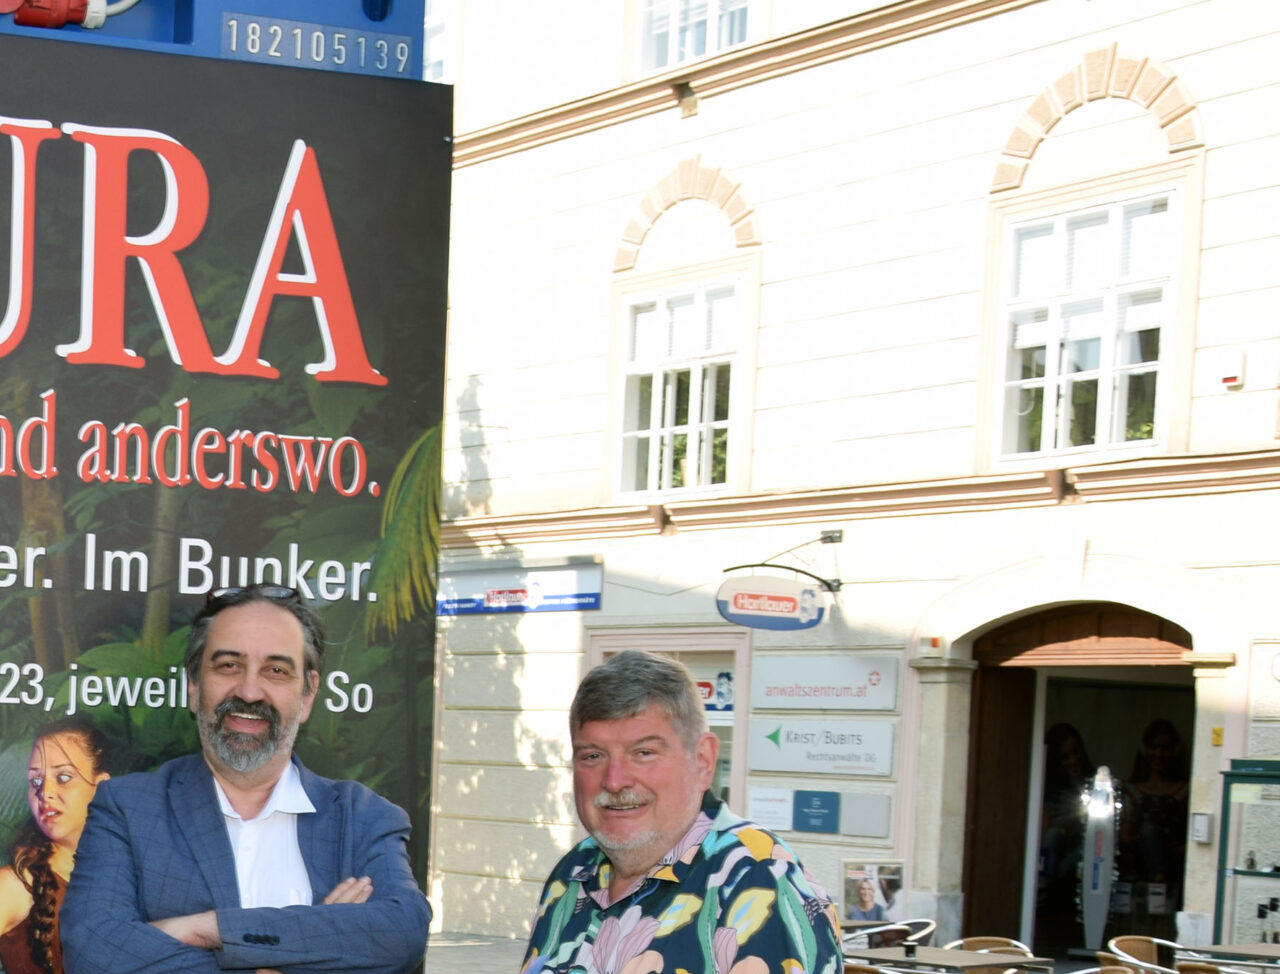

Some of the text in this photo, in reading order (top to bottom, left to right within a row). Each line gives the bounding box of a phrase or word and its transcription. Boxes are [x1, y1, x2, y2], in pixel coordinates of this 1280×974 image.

[227, 19, 410, 73] 182105139
[77, 397, 382, 498] anderswo.
[84, 533, 148, 592] Im
[179, 537, 378, 602] Bunker.
[66, 663, 188, 716] jeweil
[325, 670, 374, 713] So
